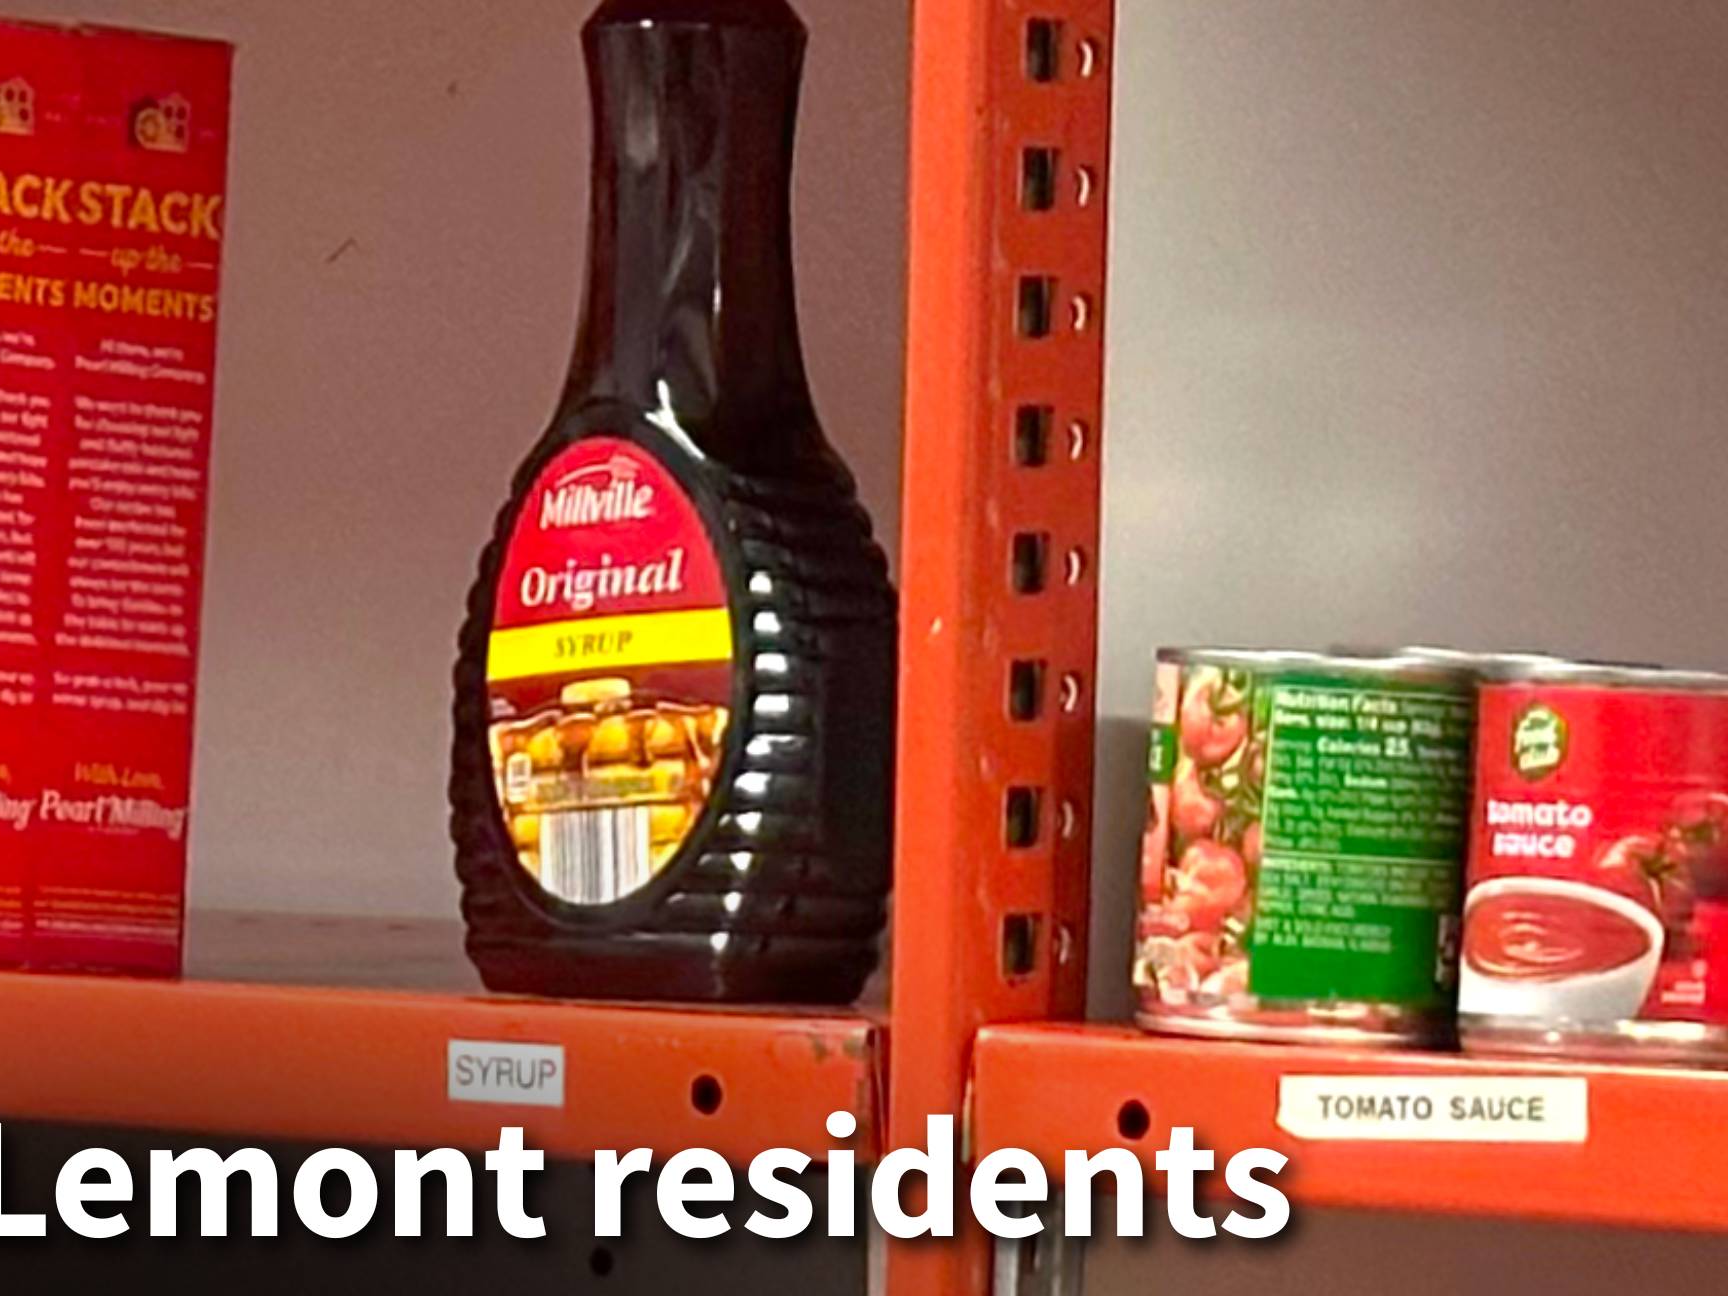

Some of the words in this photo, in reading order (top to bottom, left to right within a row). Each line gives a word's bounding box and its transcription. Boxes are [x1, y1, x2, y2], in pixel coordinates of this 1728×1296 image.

[78, 181, 224, 241] STACK
[110, 248, 142, 274] up
[144, 246, 184, 273] the
[73, 281, 216, 323] MOMENTS
[539, 479, 655, 531] Millville
[518, 548, 685, 611] Original
[552, 630, 636, 659] SYRUP
[1352, 696, 1399, 714] Facts
[1316, 737, 1382, 757] Calories
[40, 790, 104, 825] Pearl
[105, 797, 189, 841] Milling
[1487, 799, 1593, 829] tomato
[1491, 830, 1577, 860] sauce
[454, 1055, 558, 1091] SYRUP
[1319, 1095, 1434, 1122] TOMATO
[1450, 1096, 1546, 1123] SAUCE
